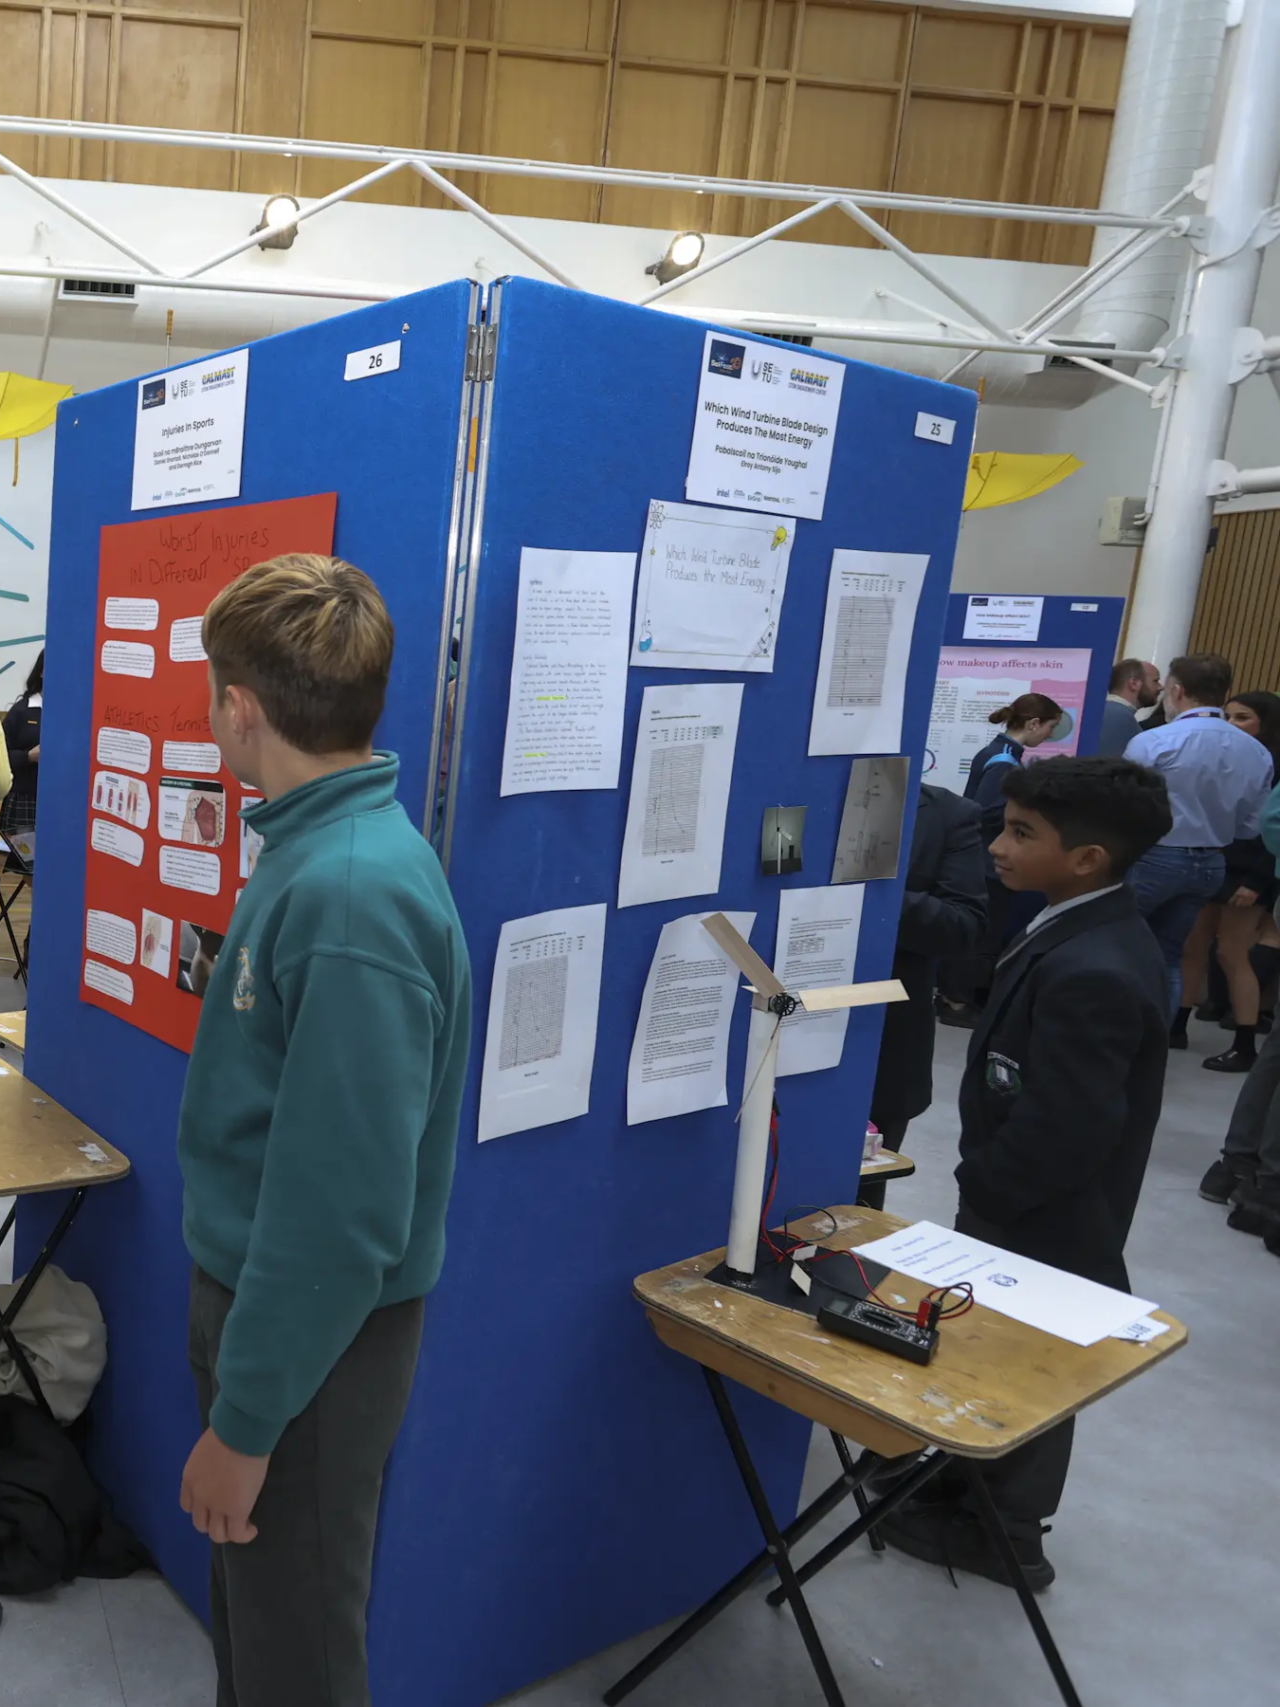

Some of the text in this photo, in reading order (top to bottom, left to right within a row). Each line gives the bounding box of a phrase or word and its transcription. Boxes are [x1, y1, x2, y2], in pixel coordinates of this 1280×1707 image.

[368, 353, 383, 369] 26
[763, 362, 774, 372] SE
[762, 372, 772, 383] TU
[704, 401, 828, 437] Which Wind Turbine Blade Design
[161, 418, 214, 438] Injuries In Sports
[716, 419, 813, 449] Produces The Most Energy
[930, 423, 942, 436] 25
[194, 439, 222, 451] Dungarvan
[740, 460, 753, 470] Elroy
[754, 463, 771, 474] Antony
[747, 451, 756, 460] na
[784, 458, 808, 469] Youghal
[716, 488, 730, 498] intel
[665, 543, 687, 561] Which
[710, 549, 737, 566] Turbine
[738, 552, 761, 569] Blade
[665, 560, 698, 582] Produces
[721, 570, 739, 586] Most
[739, 572, 767, 594] Energy
[938, 658, 1064, 670] ow makeup affects skin
